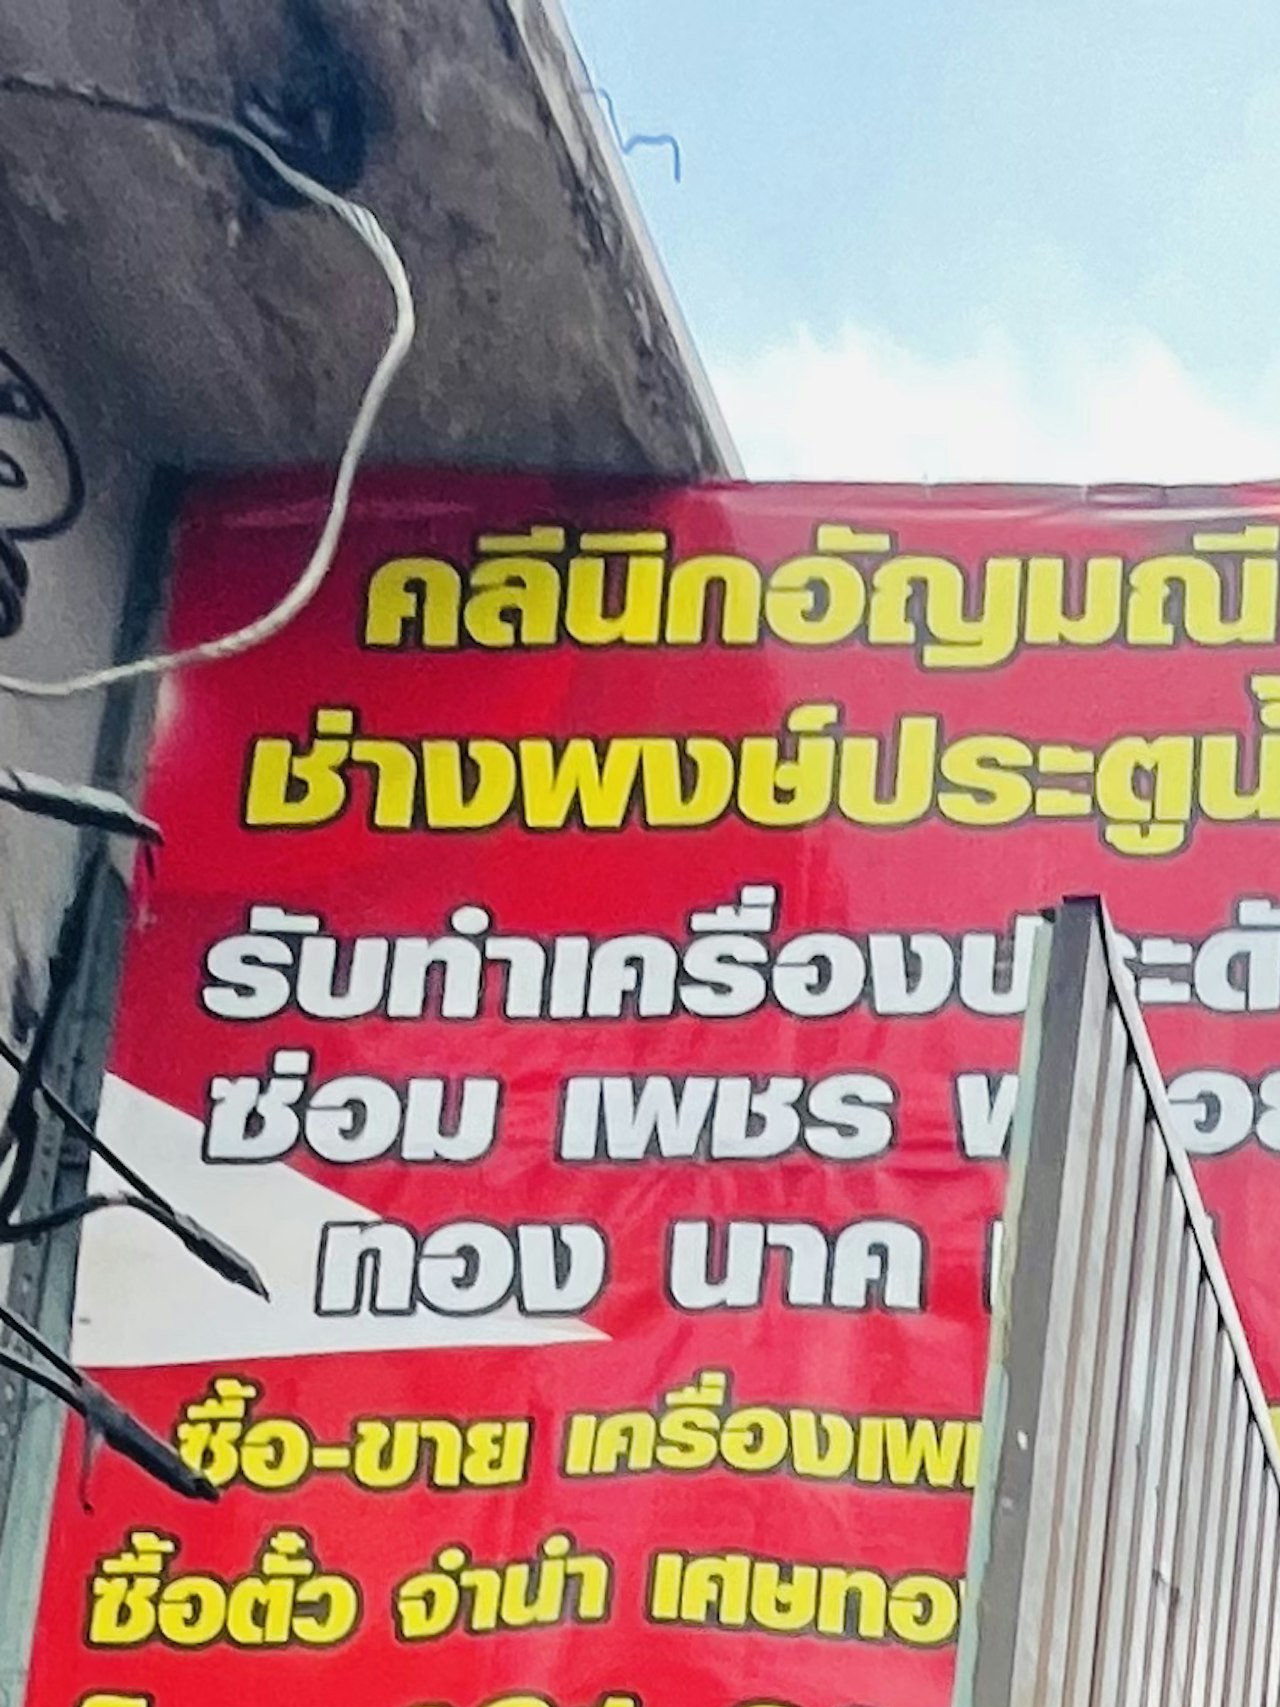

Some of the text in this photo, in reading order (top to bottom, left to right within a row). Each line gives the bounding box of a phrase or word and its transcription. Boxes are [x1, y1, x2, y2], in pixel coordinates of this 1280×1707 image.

[204, 1049, 498, 1162] ซ่อม
[558, 1073, 895, 1160] เพชร
[314, 1220, 606, 1316] ทอง
[668, 1217, 924, 1311] นาค
[397, 1534, 610, 1640] จำนำ
[650, 1551, 967, 1645] เศษทอ
